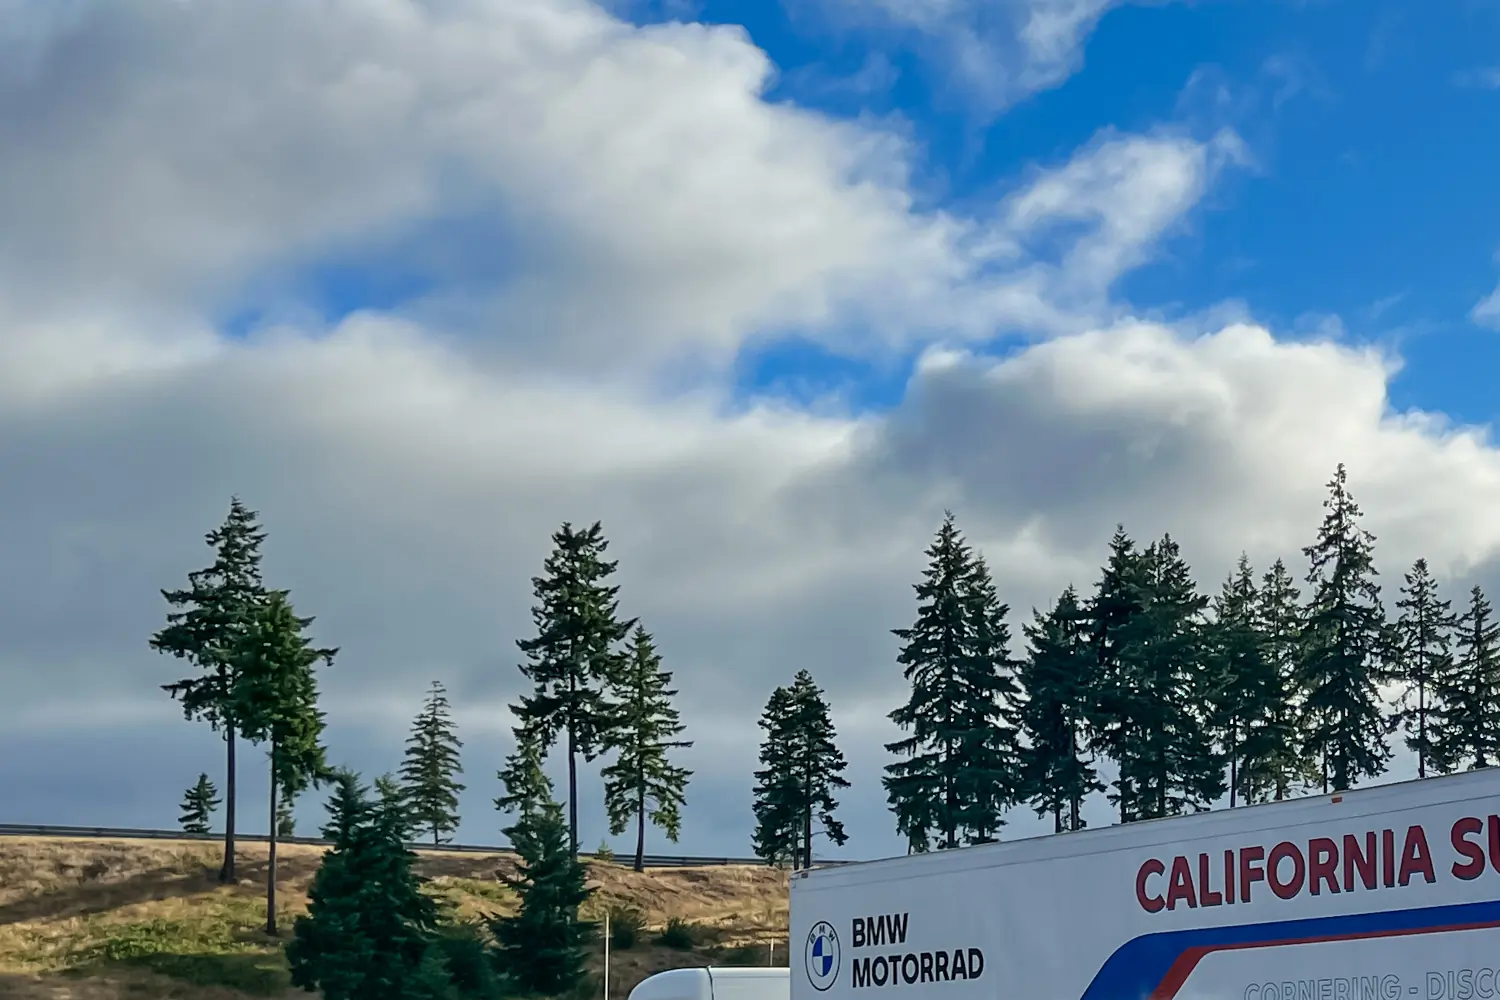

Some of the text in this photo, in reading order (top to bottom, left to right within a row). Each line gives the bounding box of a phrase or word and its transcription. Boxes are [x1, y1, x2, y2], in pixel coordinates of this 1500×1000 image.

[1136, 825, 1436, 913] CALIFORNIA
[852, 912, 909, 948] BMW
[852, 948, 984, 988] MOTORRAD
